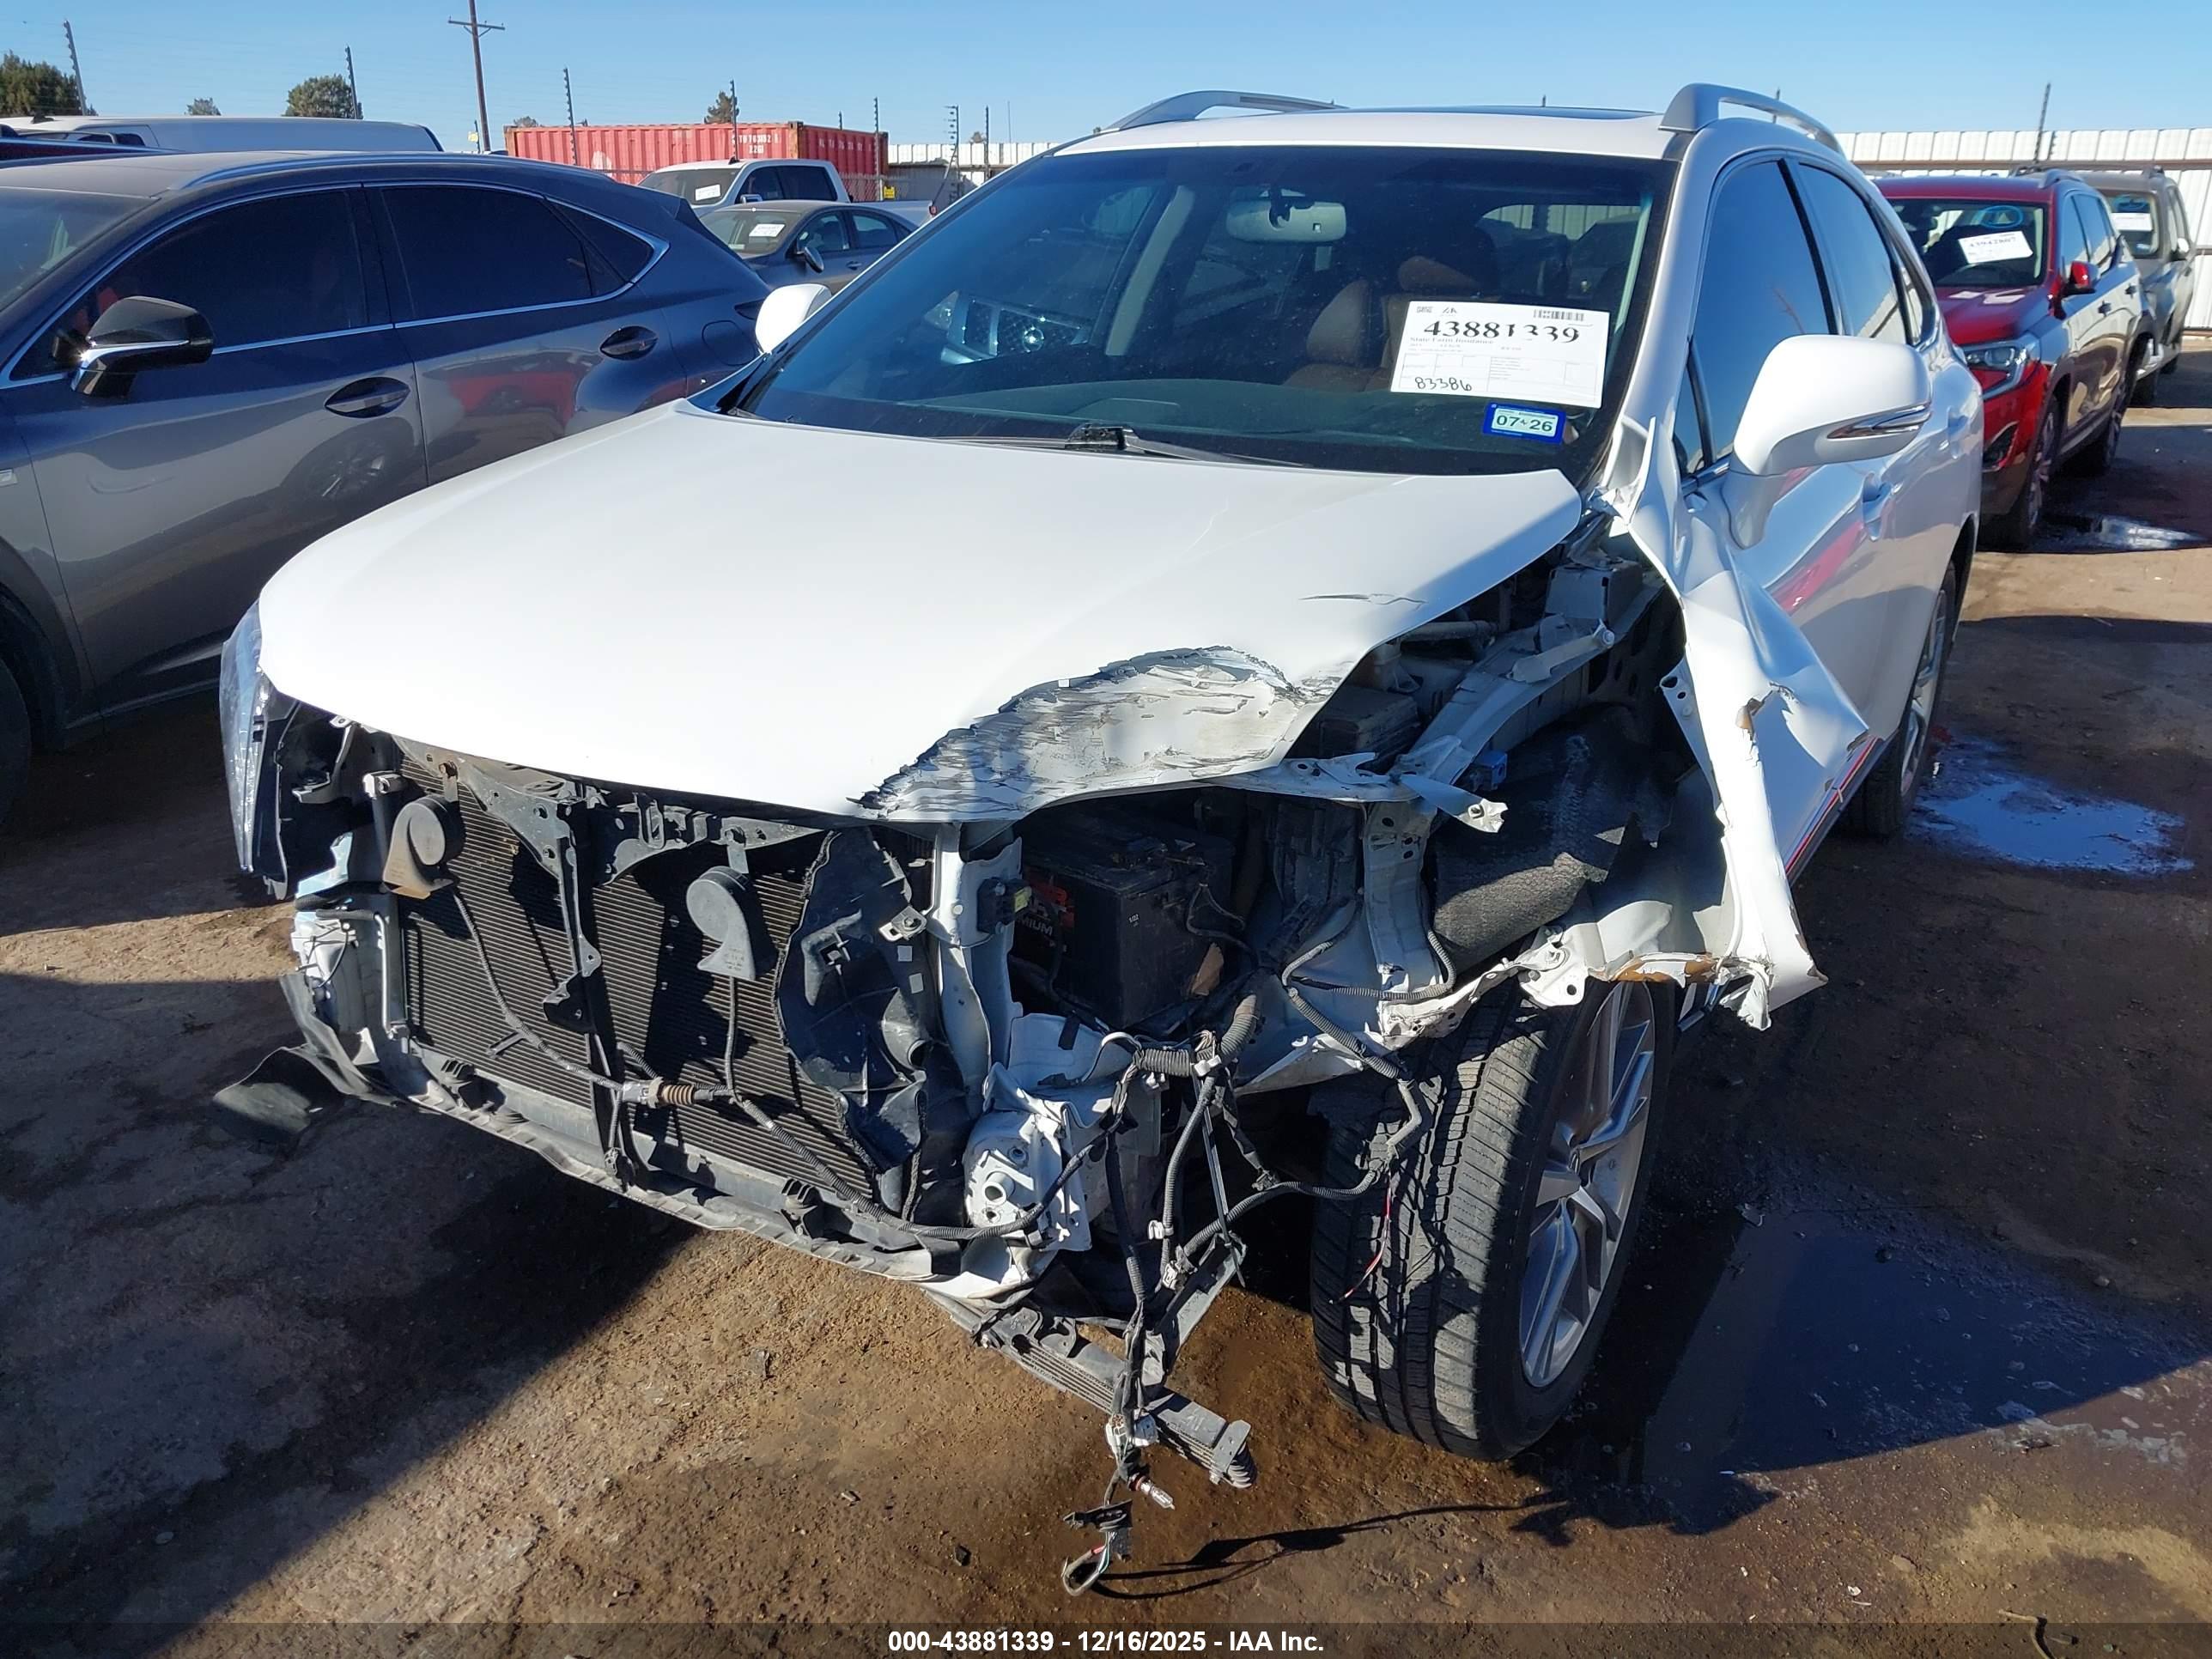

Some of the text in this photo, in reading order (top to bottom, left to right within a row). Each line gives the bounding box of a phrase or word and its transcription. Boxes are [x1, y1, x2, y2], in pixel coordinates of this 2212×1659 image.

[1423, 319, 1581, 343] 43881339
[1414, 376, 1473, 392] 83386
[1497, 415, 1520, 427] 07
[1529, 419, 1553, 432] 26
